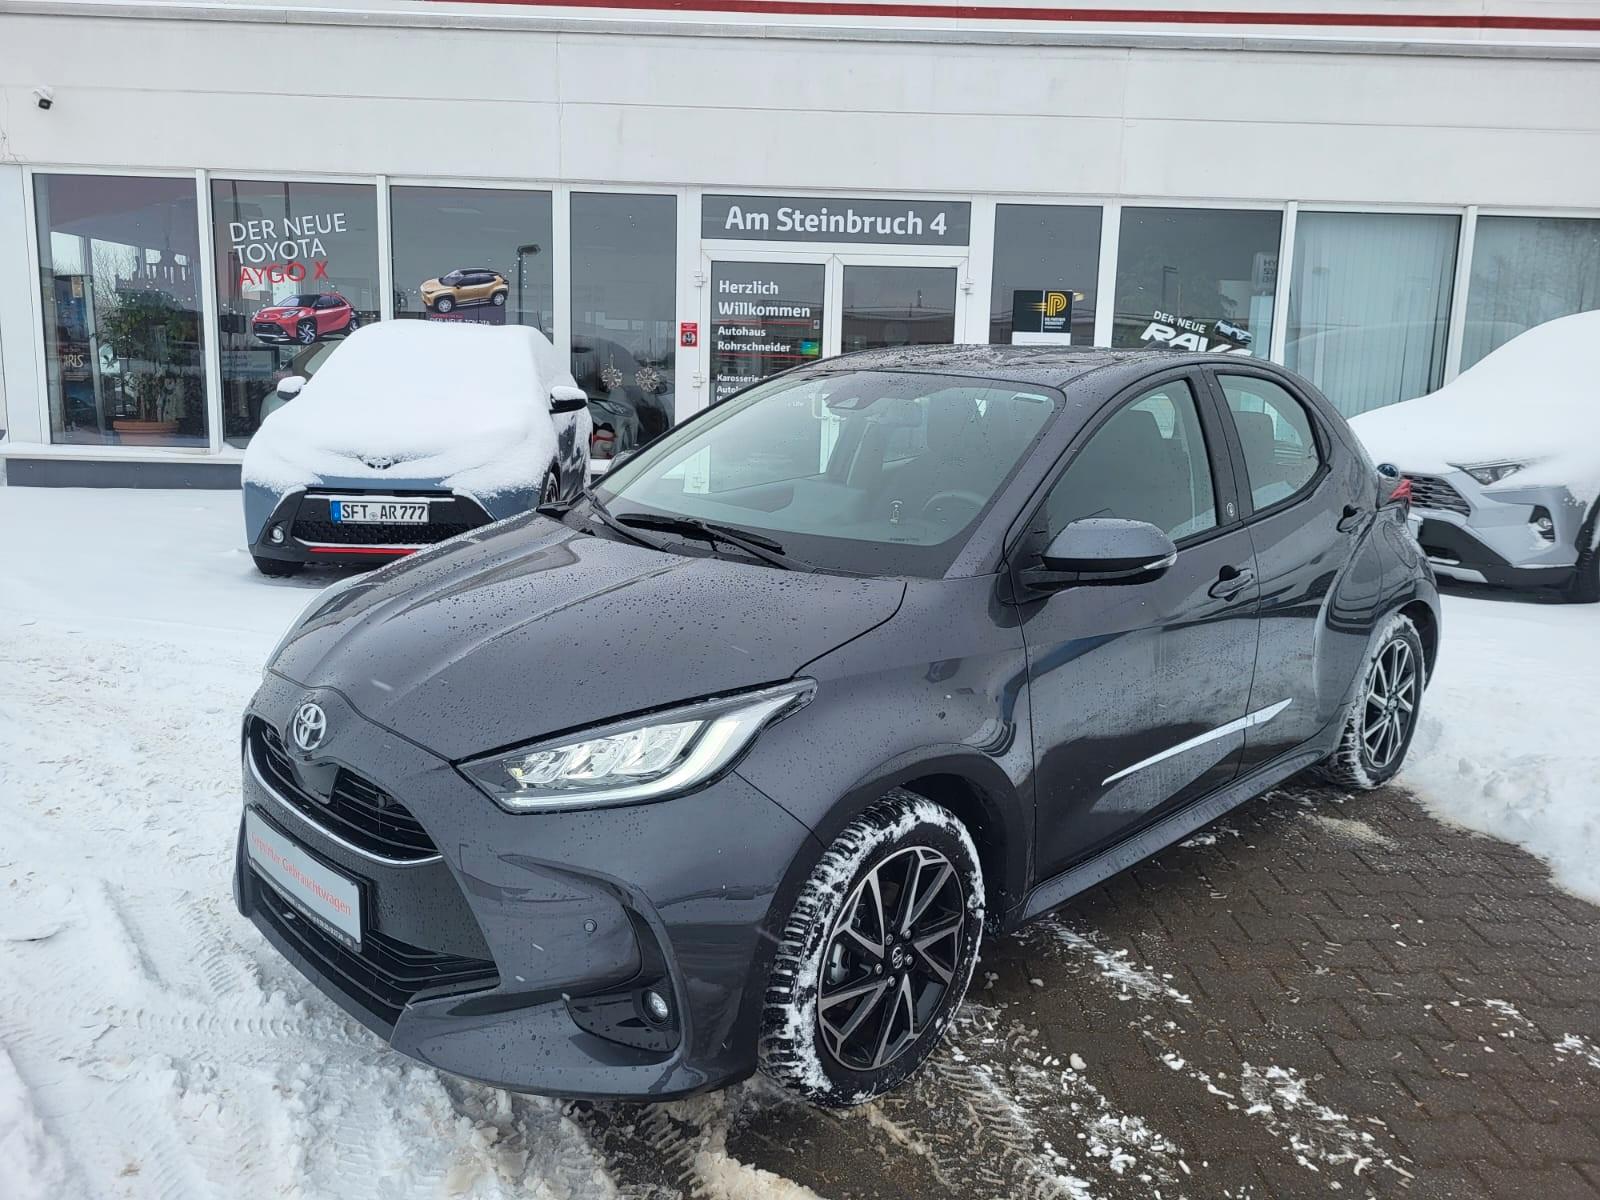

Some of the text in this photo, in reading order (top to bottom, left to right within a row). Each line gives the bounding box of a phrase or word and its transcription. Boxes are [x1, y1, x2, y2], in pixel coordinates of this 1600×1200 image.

[229, 212, 347, 242] DER NEUE
[725, 205, 947, 236] Am Steinbruch 4
[232, 238, 327, 265] TOYOTA
[239, 260, 329, 288] AYGO X
[718, 279, 779, 296] Herzlich
[717, 301, 811, 318] Willkommen
[717, 325, 767, 338] Autohaus
[1153, 310, 1207, 334] DER NEUE
[717, 340, 792, 353] Rohrschneider
[342, 504, 426, 520] SFT AR 777
